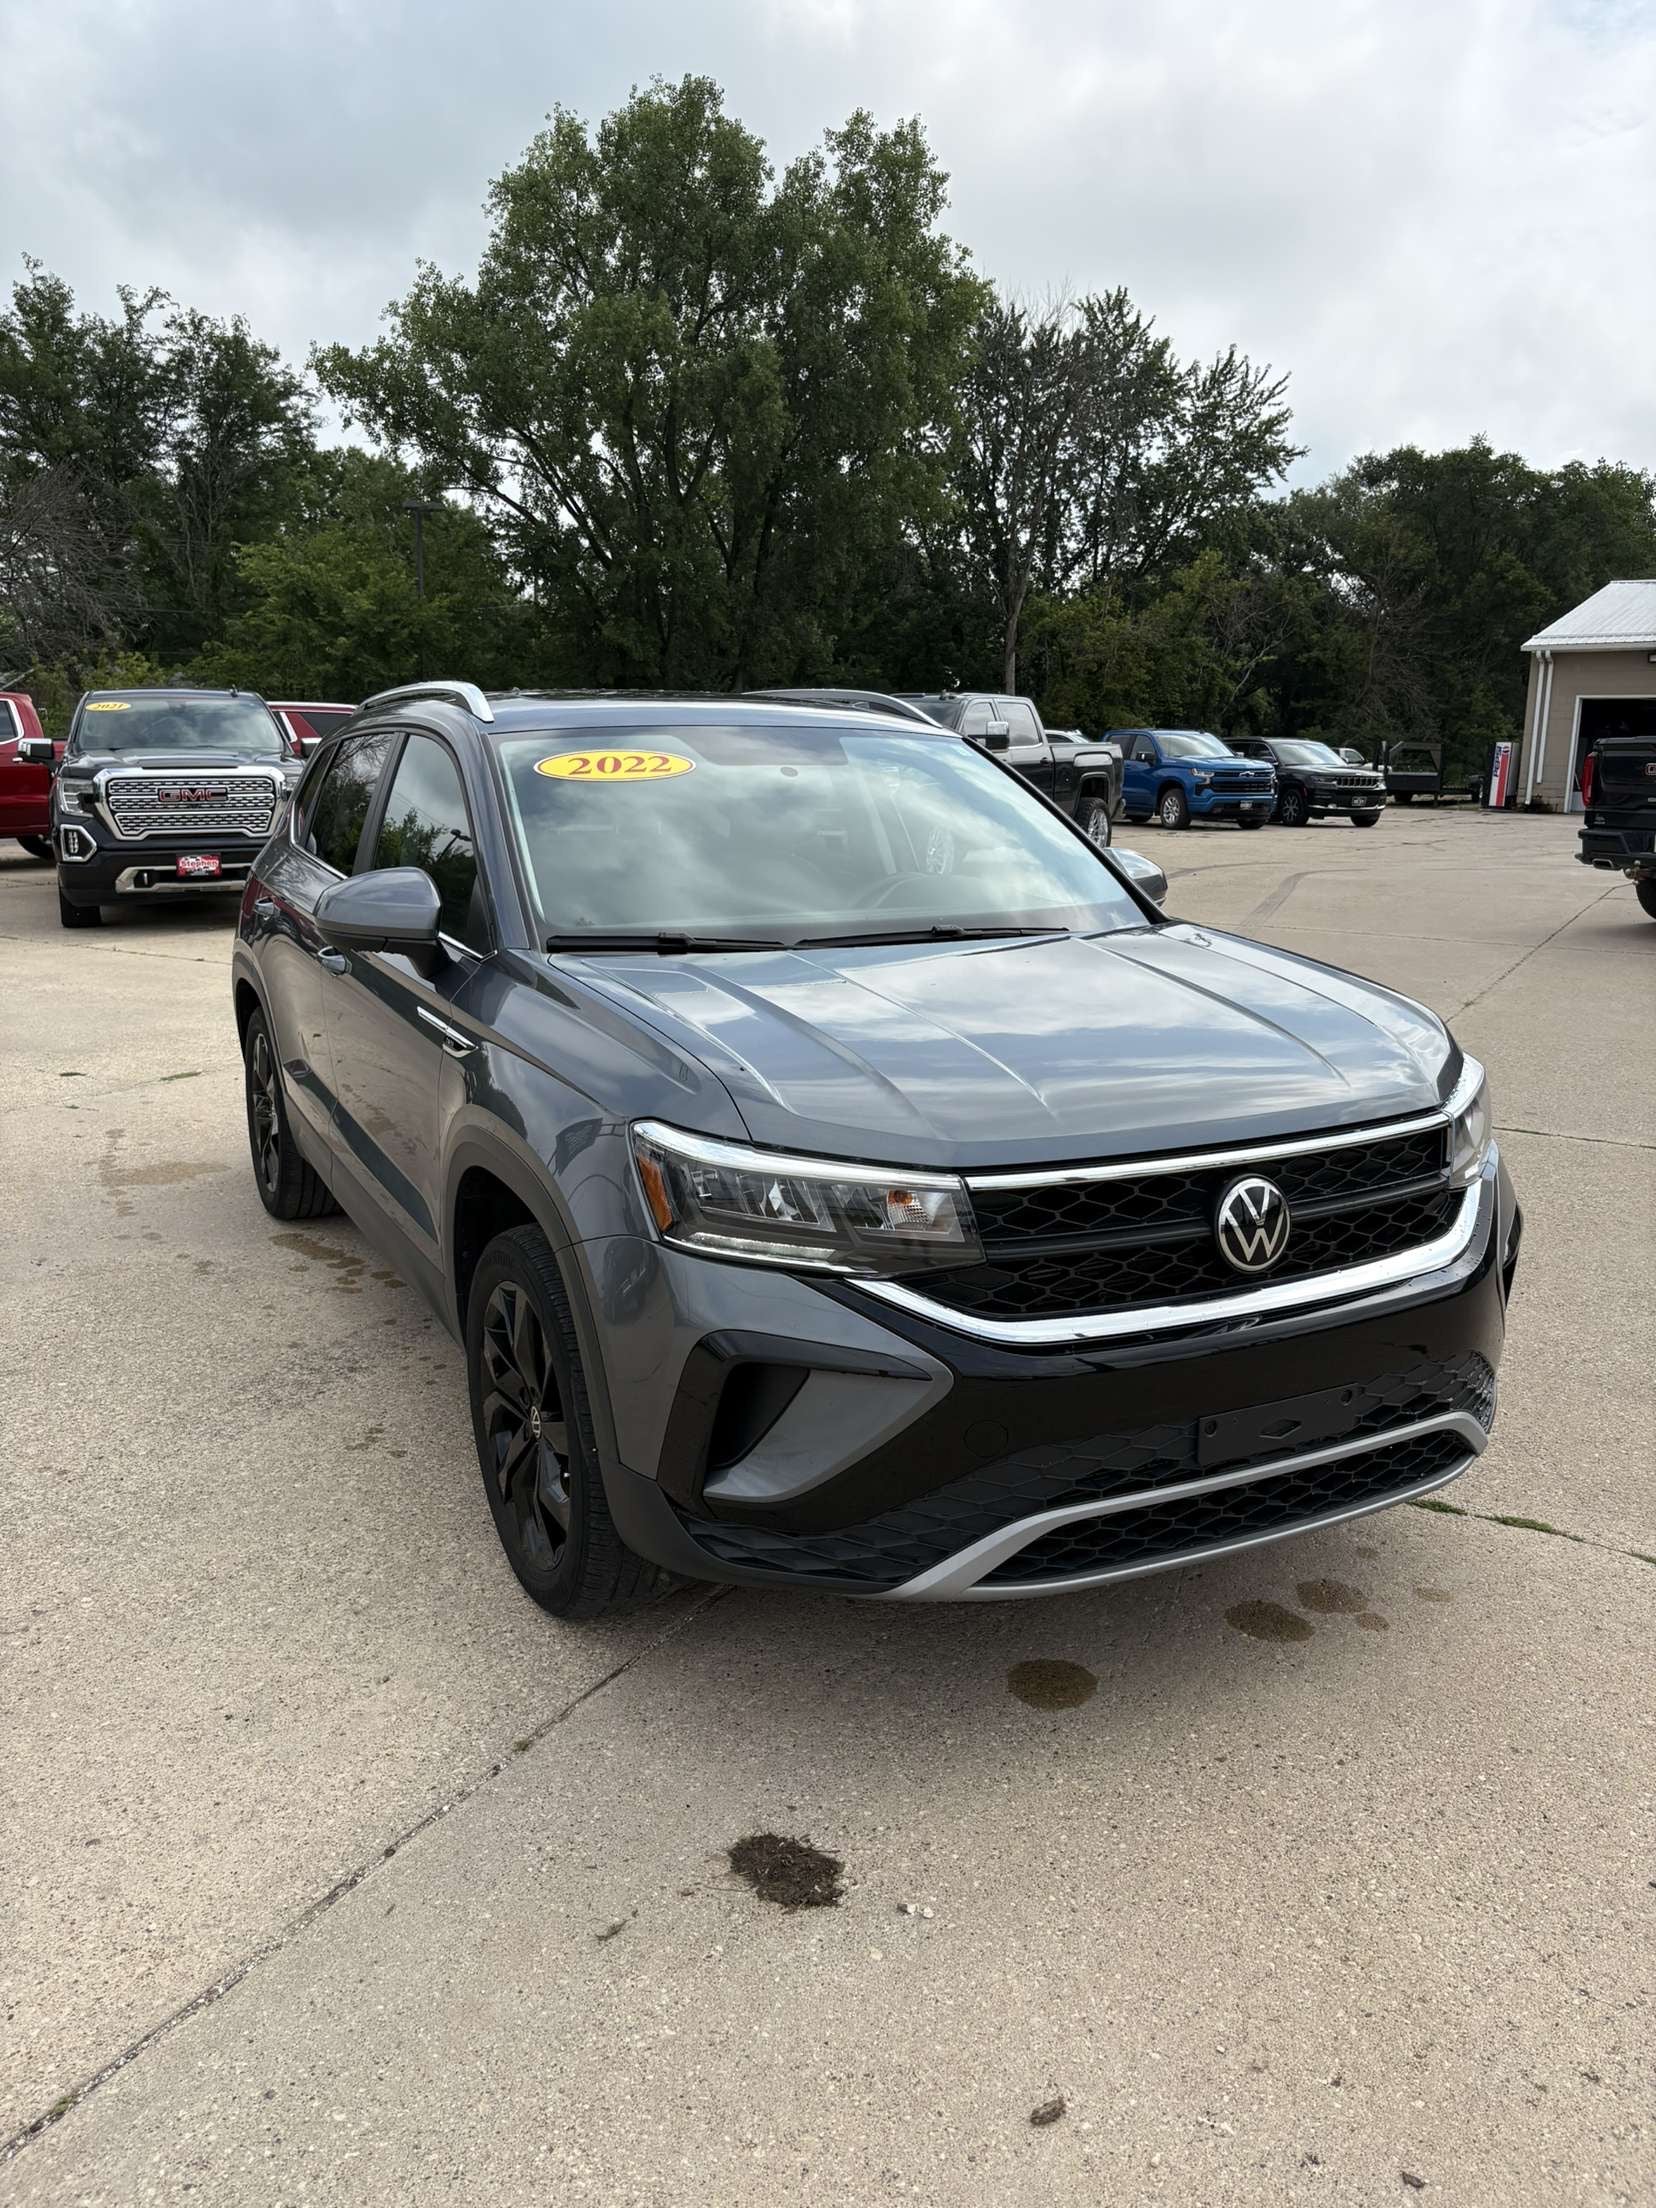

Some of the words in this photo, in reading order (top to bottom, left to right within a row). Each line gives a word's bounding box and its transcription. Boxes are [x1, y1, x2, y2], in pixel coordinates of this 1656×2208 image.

[568, 756, 672, 776] 2022
[159, 788, 227, 802] GMC
[1219, 1180, 1288, 1268] VW
